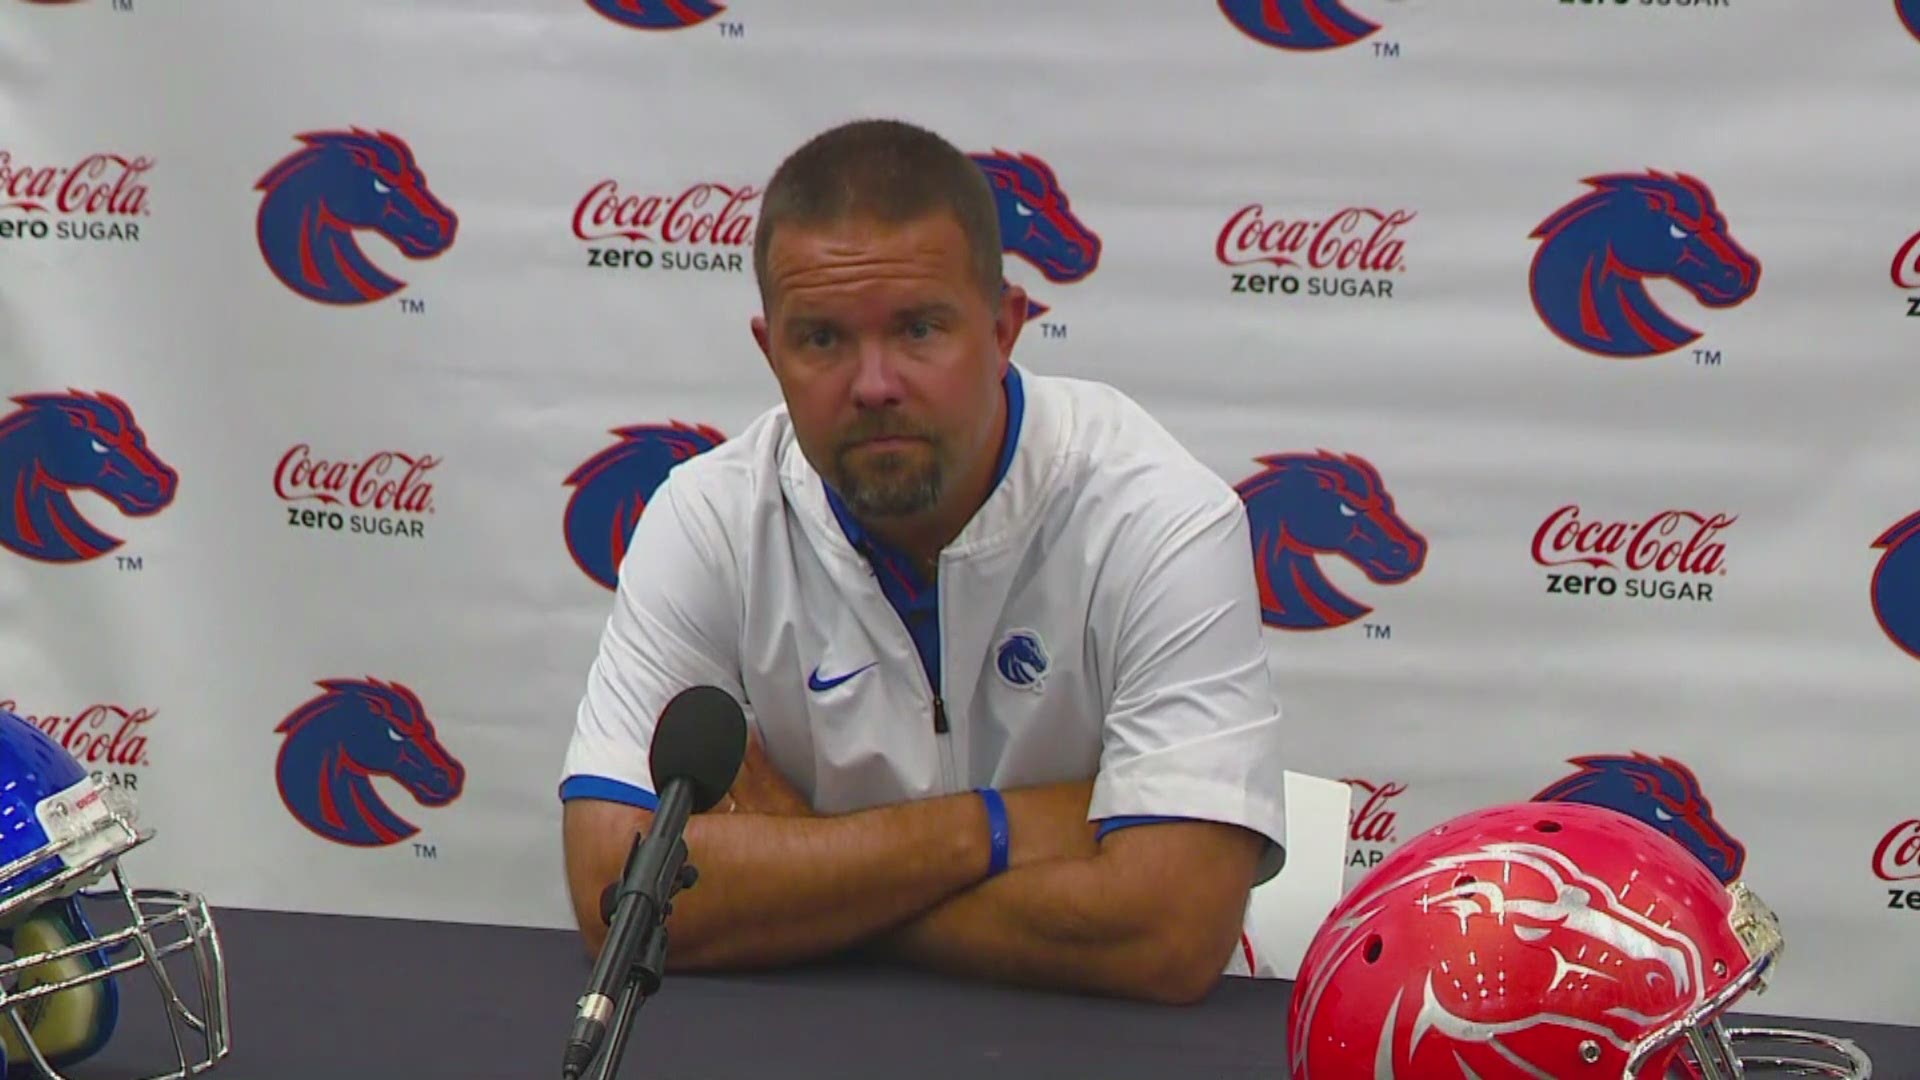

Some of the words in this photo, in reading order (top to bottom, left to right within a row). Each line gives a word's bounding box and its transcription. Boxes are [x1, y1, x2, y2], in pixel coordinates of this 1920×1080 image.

[719, 22, 744, 37] TM
[1373, 42, 1399, 58] TM
[0, 219, 48, 239] ero
[56, 221, 140, 241] SUGAR
[588, 248, 654, 268] zero
[661, 251, 742, 272] SUGAR
[1232, 273, 1300, 294] zero
[1308, 277, 1393, 298] SUGAR
[399, 299, 424, 313] TM
[1041, 323, 1067, 338] TM
[1692, 350, 1721, 366] TM
[288, 507, 343, 531] zero
[350, 515, 424, 538] SUGAR
[116, 556, 142, 571] TM
[1547, 574, 1617, 596] zero
[1625, 579, 1713, 601] SUGAR
[1363, 624, 1391, 639] TM
[413, 843, 437, 858] TM
[1887, 889, 1920, 911] ze
